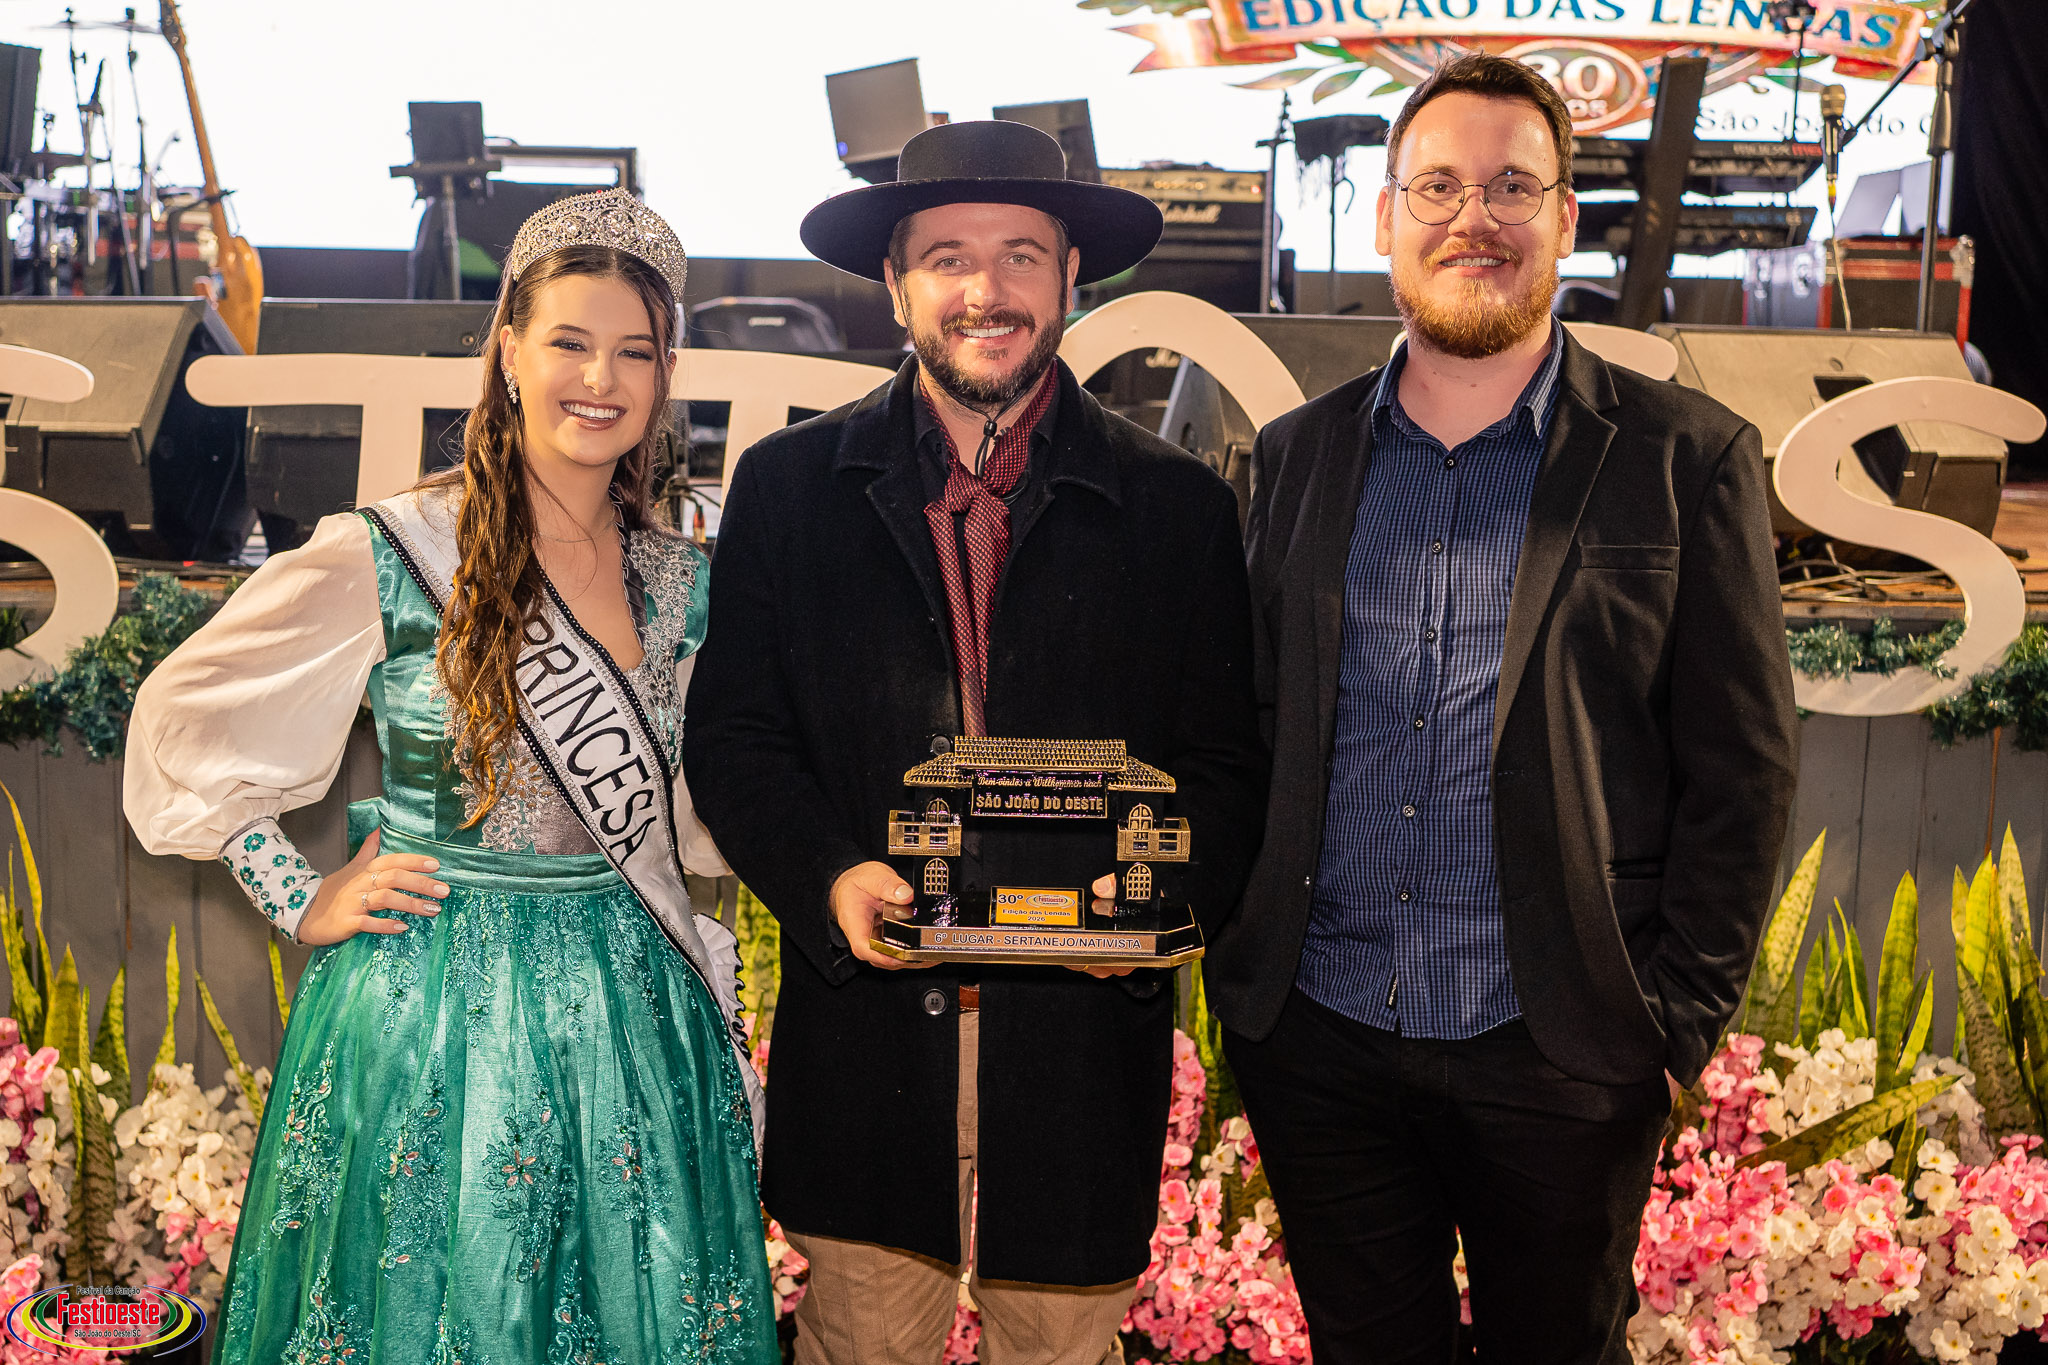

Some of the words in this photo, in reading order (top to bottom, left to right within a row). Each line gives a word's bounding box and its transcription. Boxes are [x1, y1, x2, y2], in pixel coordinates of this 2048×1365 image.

[1505, 0, 1626, 22] DAS
[1517, 54, 1617, 100] 30
[517, 611, 657, 866] PRINCESA
[976, 792, 1002, 809] SÃO
[1005, 793, 1039, 810] JOÃO
[1043, 796, 1061, 810] DO
[1064, 796, 1104, 811] OESTE
[952, 933, 994, 945] LUGAR
[1003, 935, 1142, 949] SERTANEJO/NATIVISTA
